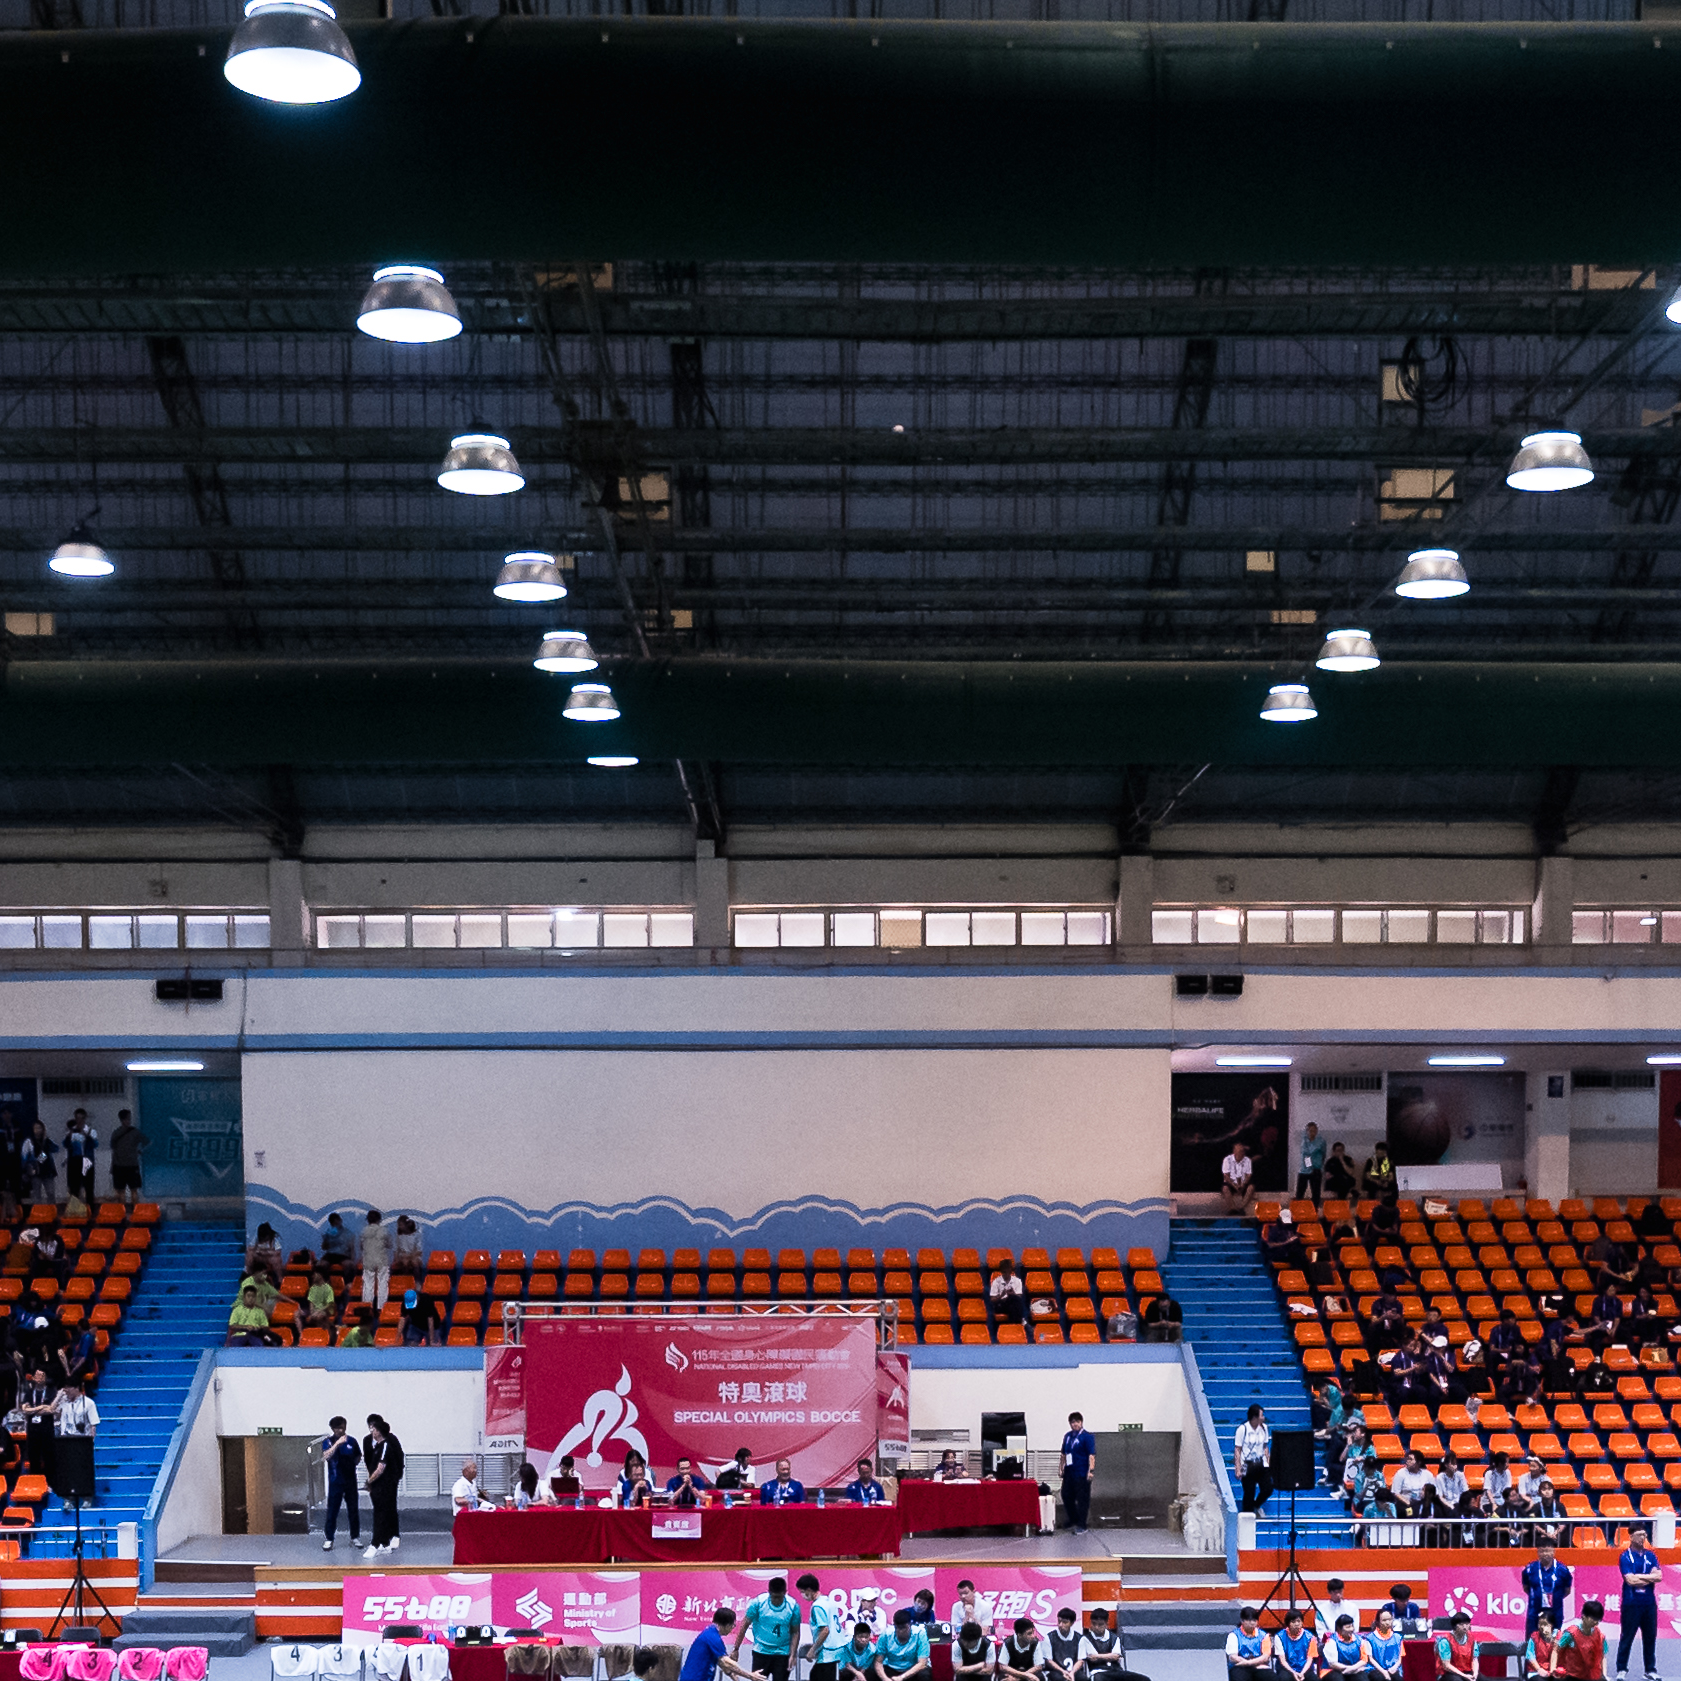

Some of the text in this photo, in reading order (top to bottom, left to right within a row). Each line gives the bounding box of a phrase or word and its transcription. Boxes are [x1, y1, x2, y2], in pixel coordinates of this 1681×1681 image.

[718, 1382, 807, 1404] 特奧滾球
[674, 1411, 861, 1423] SPECIAL OLYMPICS BOCCE
[362, 1595, 472, 1621] 55688
[1487, 1593, 1525, 1615] klo
[563, 1608, 616, 1618] Ministry of
[563, 1619, 597, 1629] Sports
[772, 1623, 782, 1638] 4
[88, 1651, 98, 1669] 3
[133, 1652, 143, 1671] 2
[291, 1646, 301, 1662] 4
[334, 1646, 342, 1662] 3
[417, 1653, 423, 1671] 1
